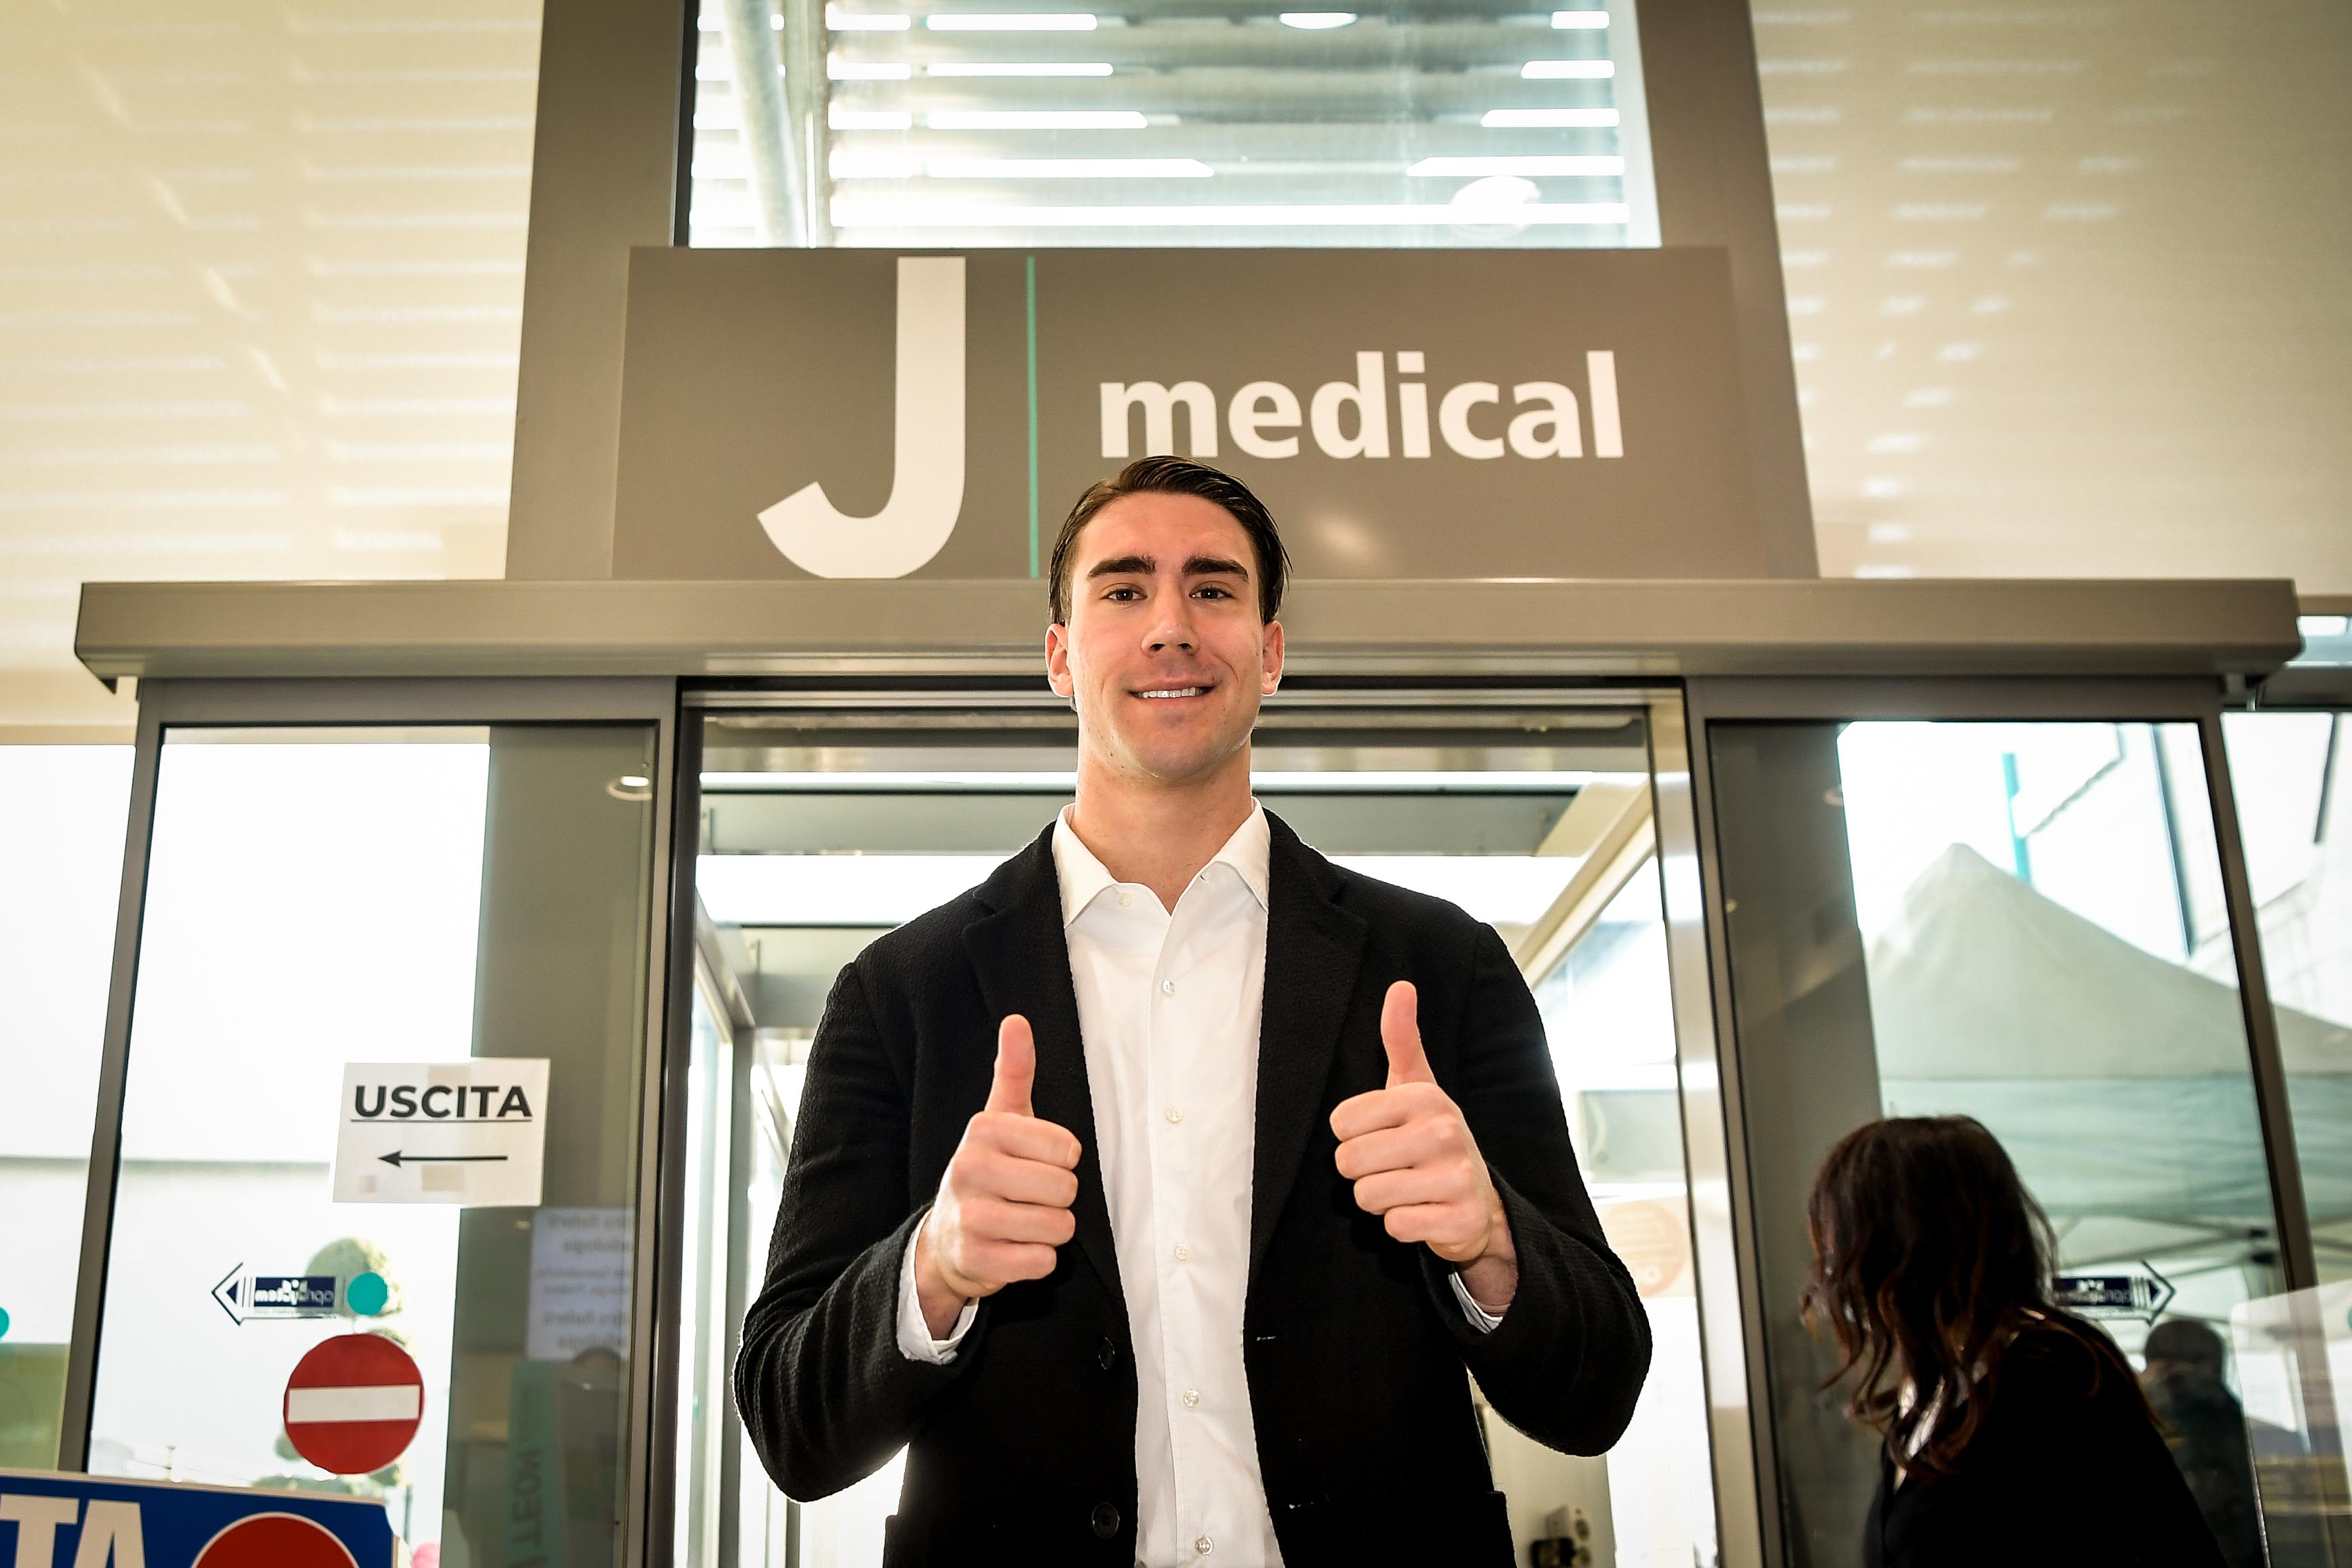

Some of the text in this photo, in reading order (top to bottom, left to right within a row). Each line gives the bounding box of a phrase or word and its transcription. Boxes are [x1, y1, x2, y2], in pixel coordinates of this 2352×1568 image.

[757, 256, 1624, 579] J medical
[354, 1085, 533, 1119] USCITA
